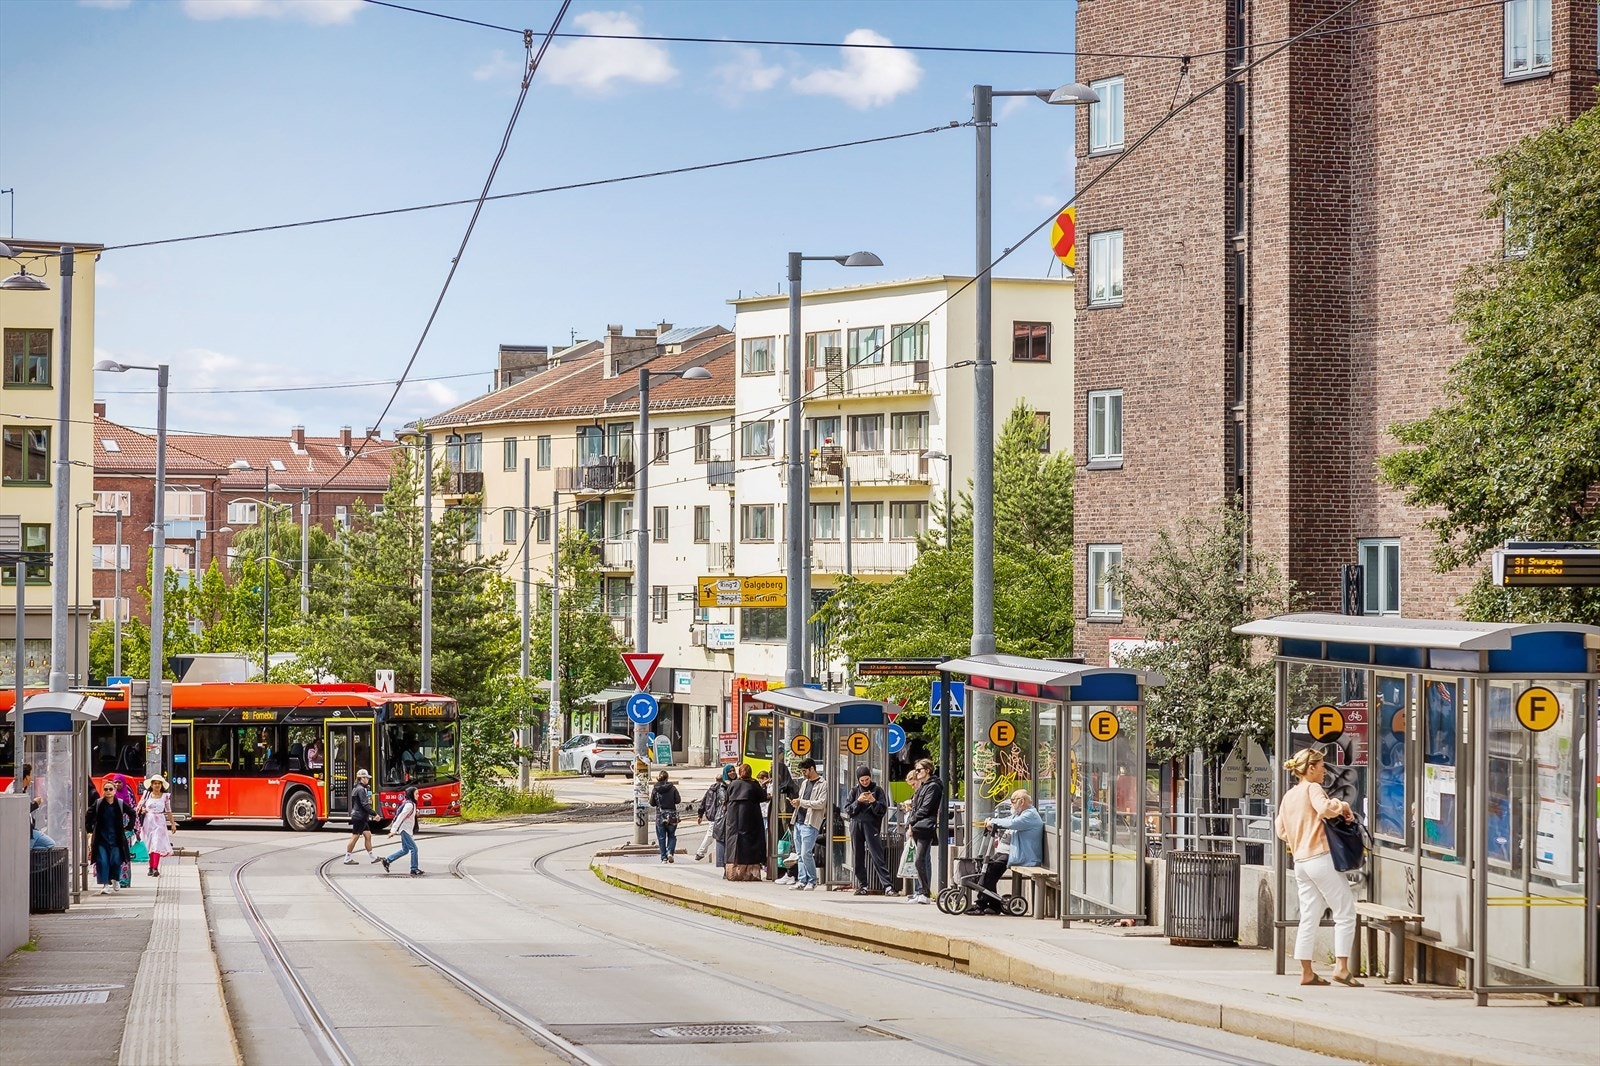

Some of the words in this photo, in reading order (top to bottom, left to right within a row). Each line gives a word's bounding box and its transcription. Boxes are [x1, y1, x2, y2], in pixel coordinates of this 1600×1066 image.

[1514, 557, 1525, 565] 31
[1514, 566, 1524, 574] 31
[1527, 566, 1563, 574] Fornebu
[720, 581, 733, 589] Ring
[743, 580, 783, 590] Galgeberg
[744, 594, 777, 602] Sentrum
[744, 679, 765, 691] EXTRA
[394, 703, 403, 716] 28
[410, 703, 443, 716] Fornebu
[1530, 696, 1547, 722] F
[242, 711, 249, 720] 28
[252, 711, 274, 720] Fornebu
[1098, 717, 1110, 735] E
[1318, 713, 1334, 735] F
[997, 725, 1008, 741] E
[797, 739, 806, 751] E
[854, 737, 863, 750] E
